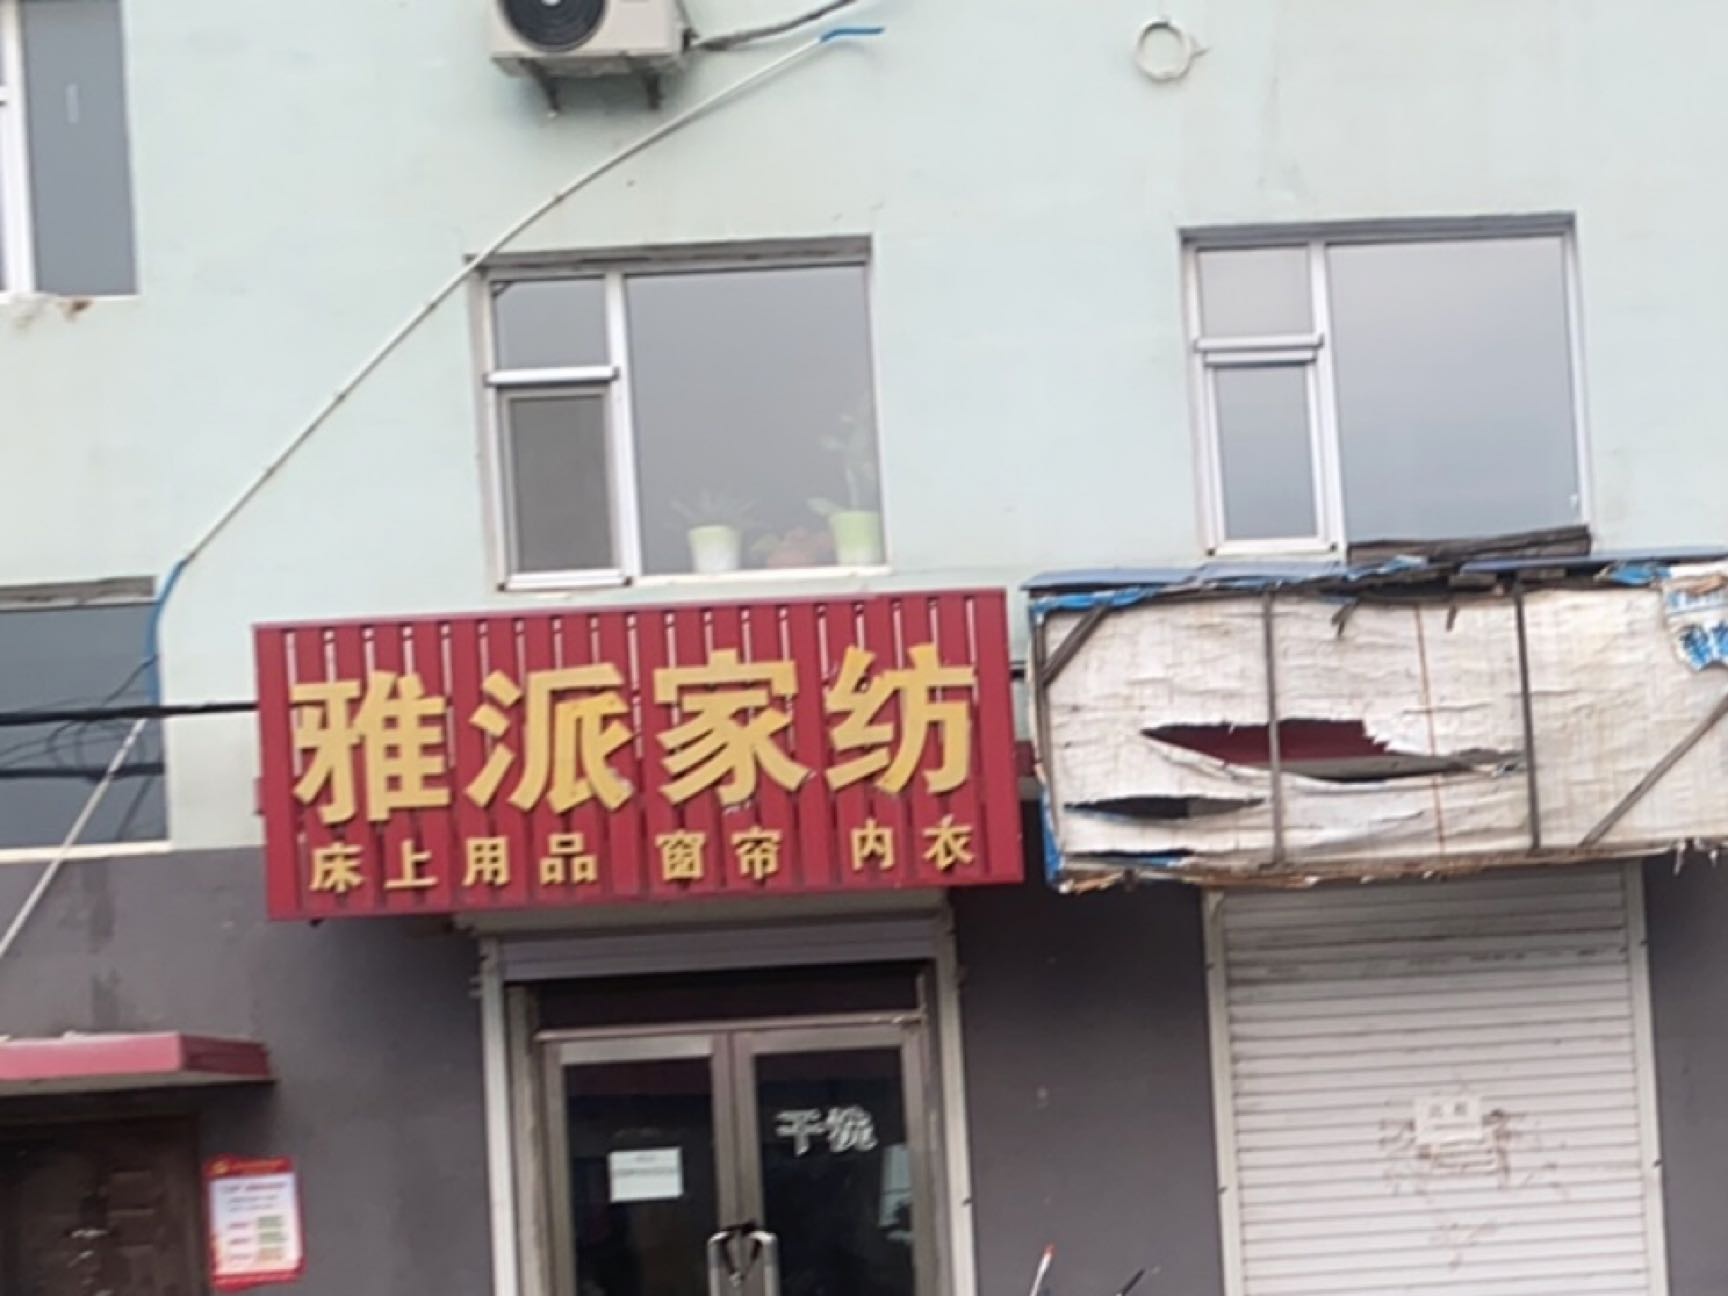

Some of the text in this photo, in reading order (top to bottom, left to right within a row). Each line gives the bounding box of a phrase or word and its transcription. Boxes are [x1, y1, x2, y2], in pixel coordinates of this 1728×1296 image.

[291, 642, 977, 825] 雅派家纺
[309, 813, 976, 893] 床上用品 窗帘 内衣
